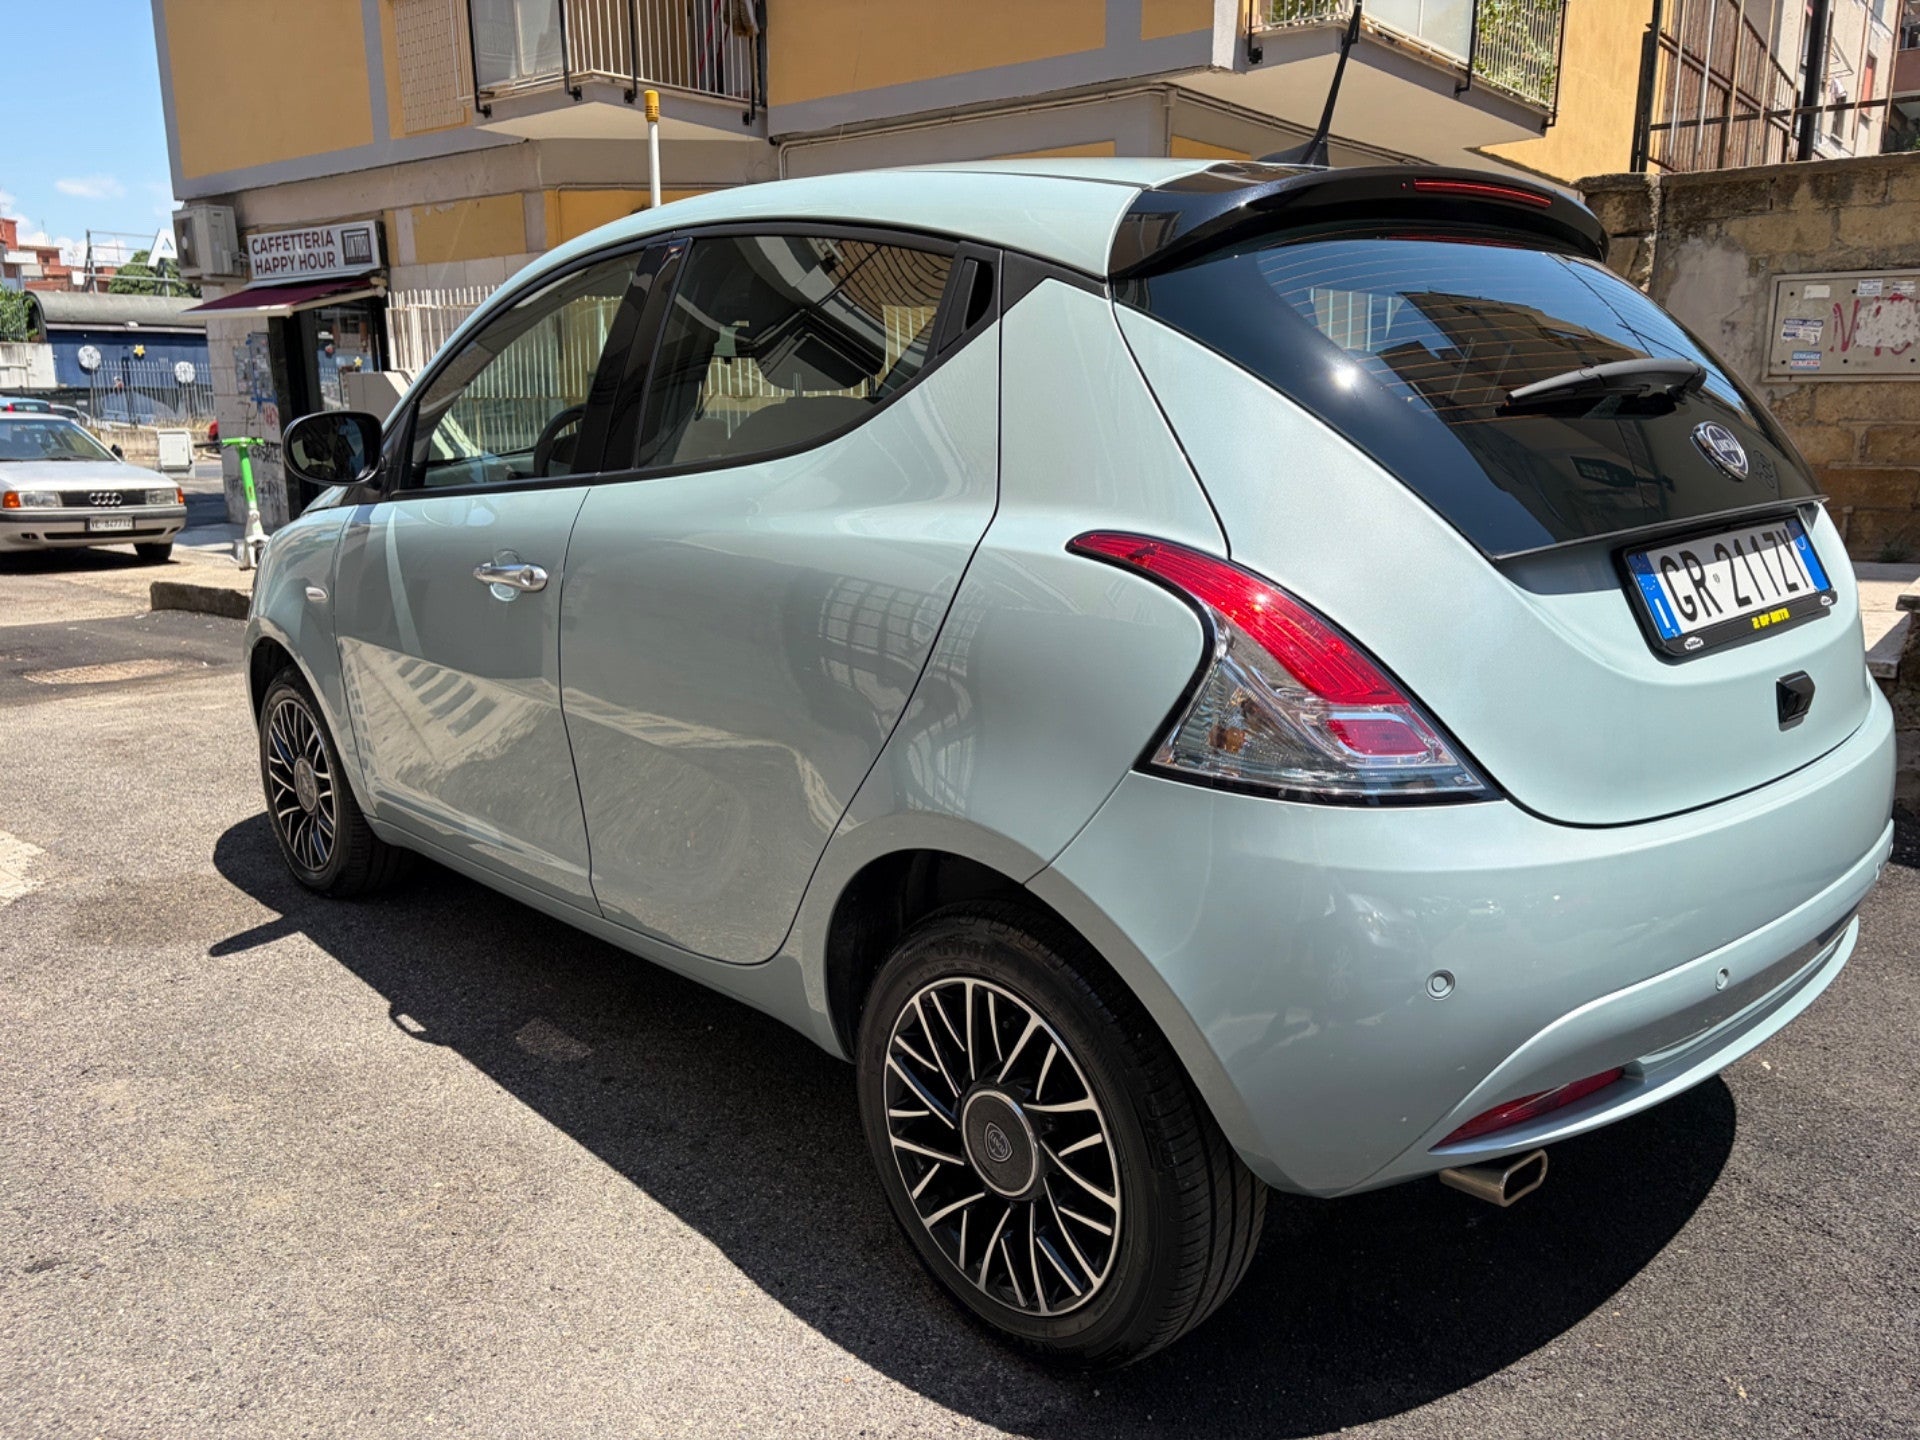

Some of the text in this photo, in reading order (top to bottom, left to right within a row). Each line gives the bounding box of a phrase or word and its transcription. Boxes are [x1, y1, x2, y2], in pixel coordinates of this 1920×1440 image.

[251, 230, 336, 256] CAFFETTERIA
[255, 251, 337, 275] HAPPY HOUR
[1660, 549, 1724, 623] GR
[1713, 528, 1810, 609] 211ZY
